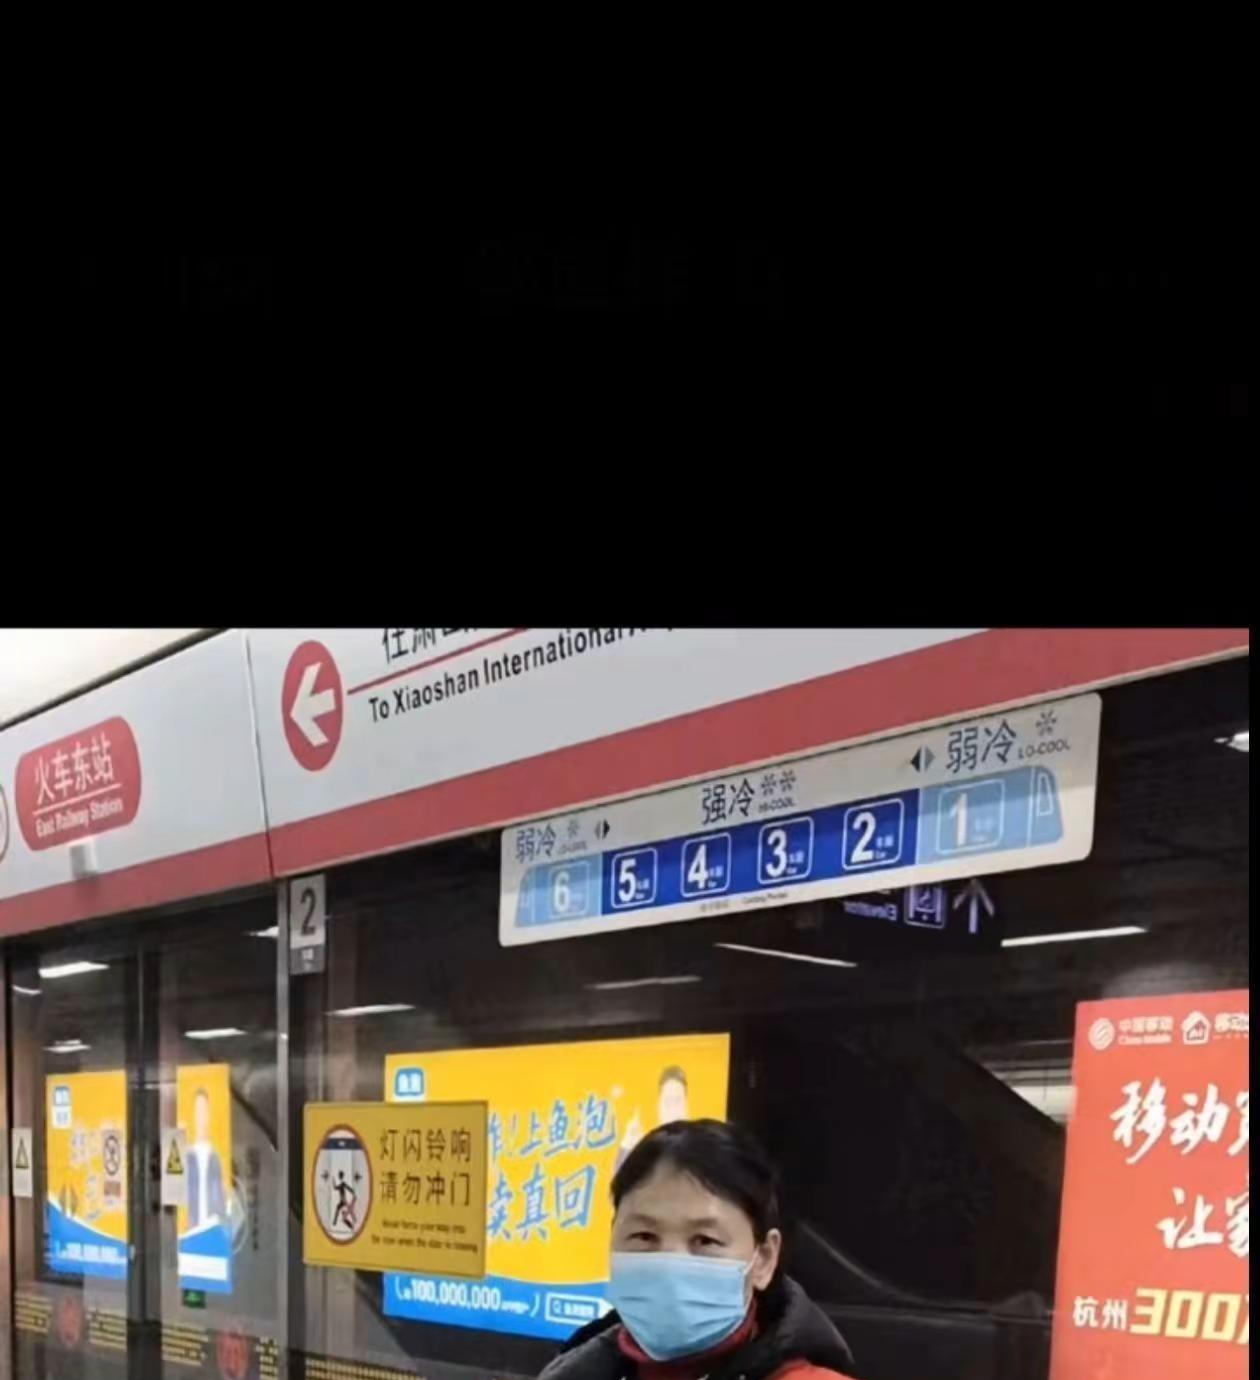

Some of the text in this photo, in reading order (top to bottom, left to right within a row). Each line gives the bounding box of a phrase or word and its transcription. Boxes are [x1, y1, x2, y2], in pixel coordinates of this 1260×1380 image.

[369, 628, 623, 722] To Xiaoshan International
[35, 732, 115, 805] 火车东站
[946, 719, 1017, 774] 弱冷
[36, 797, 124, 838] East Railway Station
[702, 778, 755, 826] 强冷
[951, 792, 969, 847] 1
[515, 824, 556, 863] 弱冷
[766, 828, 788, 878] 3
[850, 811, 877, 864] 2
[618, 857, 637, 902] 5
[687, 843, 709, 889] 4
[301, 885, 316, 937] 2
[553, 869, 571, 914] 6
[379, 1127, 471, 1163] 灯闪铃响
[379, 1171, 470, 1206] 请勿冲门
